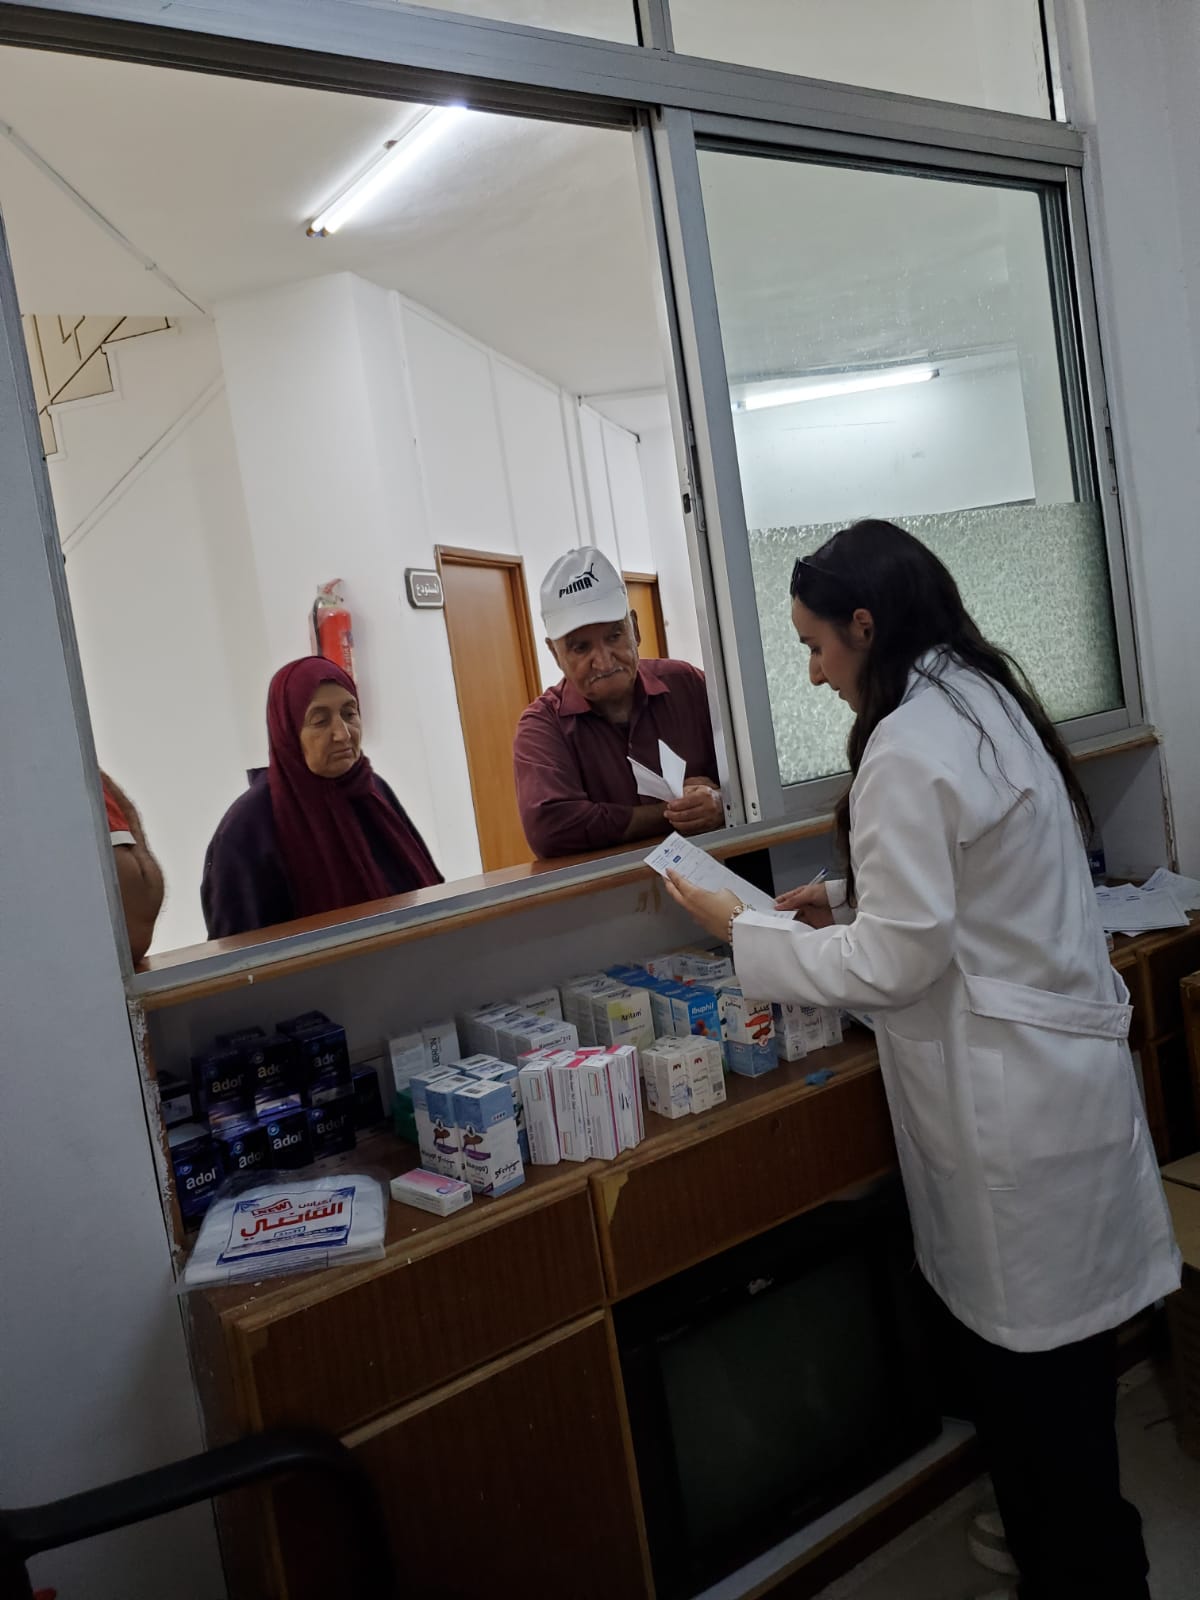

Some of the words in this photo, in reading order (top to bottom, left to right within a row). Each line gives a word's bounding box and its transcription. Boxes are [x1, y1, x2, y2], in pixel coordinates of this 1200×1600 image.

[559, 577, 593, 598] PUMA
[212, 1074, 243, 1093] adol
[272, 1130, 302, 1150] adol
[185, 1168, 217, 1190] adol
[257, 1201, 287, 1214] NEW
